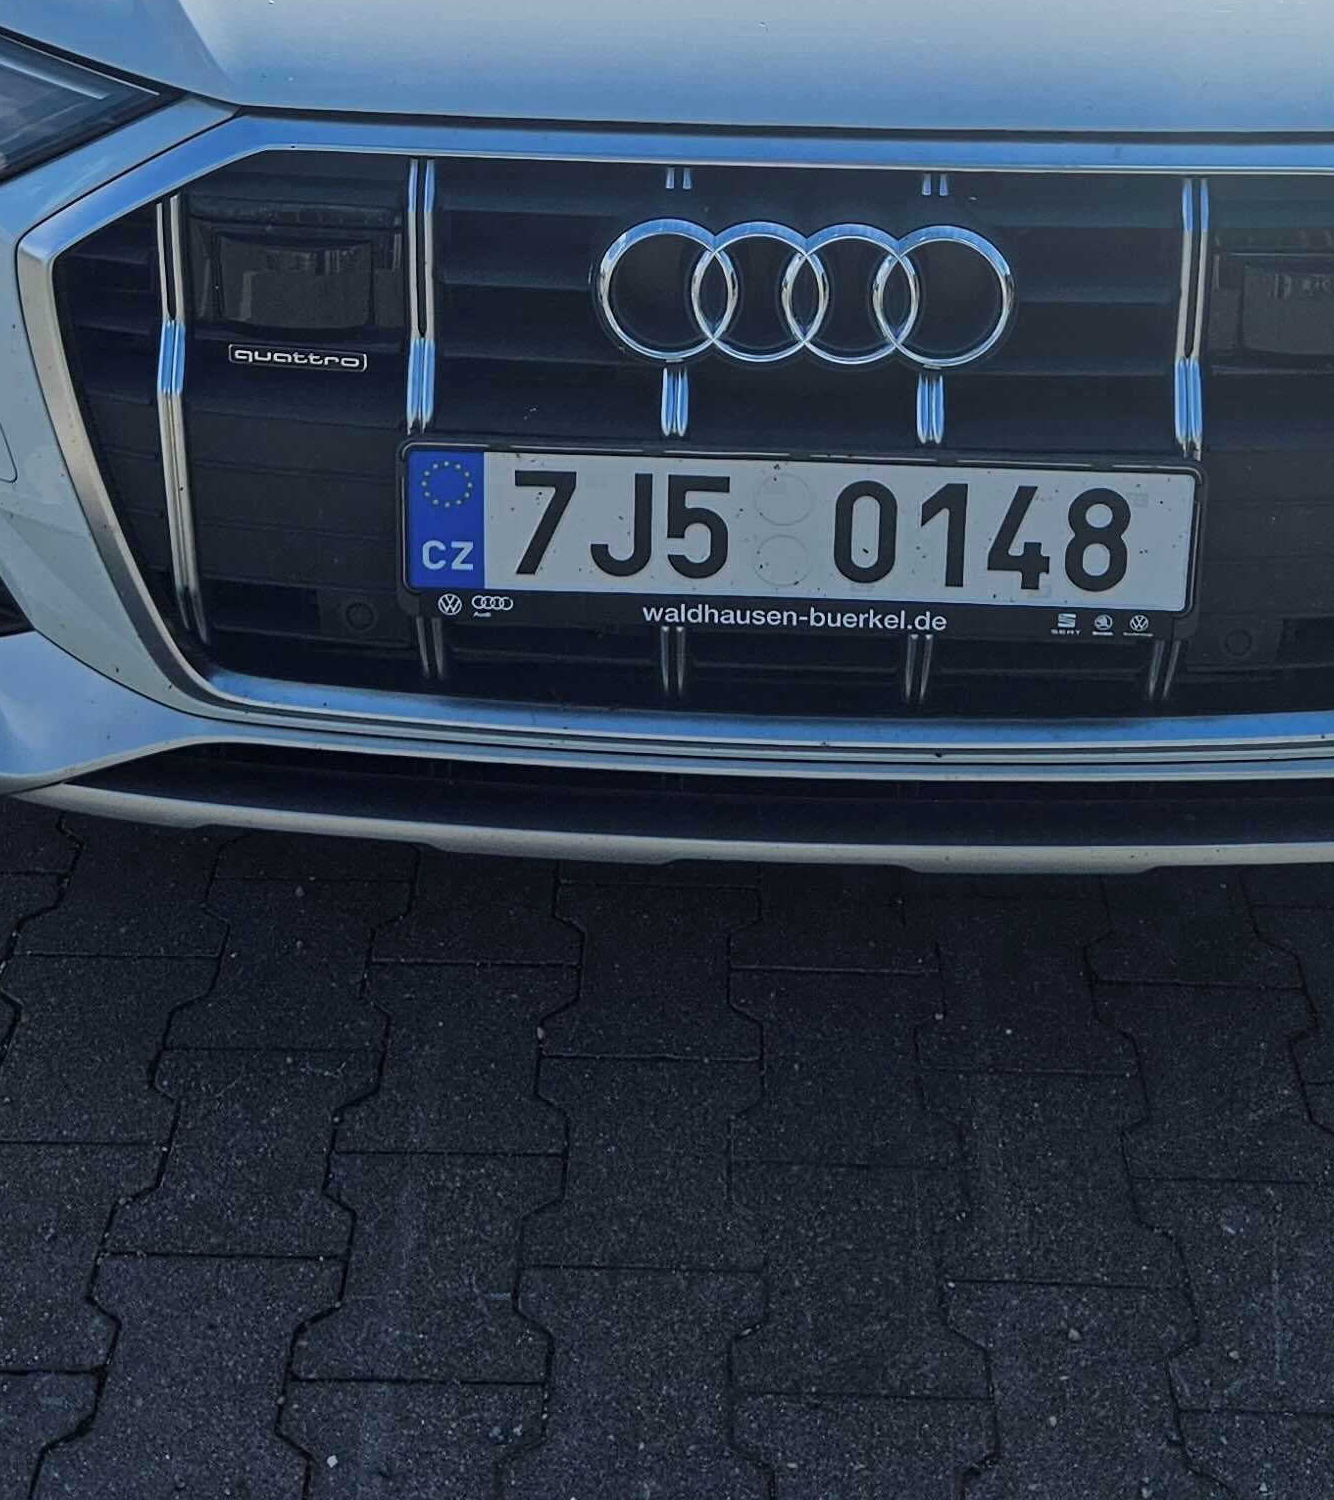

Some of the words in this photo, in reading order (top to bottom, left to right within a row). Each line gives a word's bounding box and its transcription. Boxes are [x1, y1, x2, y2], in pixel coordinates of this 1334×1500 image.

[234, 349, 360, 368] quattro
[514, 469, 732, 579] 7J5
[833, 479, 1133, 593] 0148
[421, 538, 475, 572] CZ
[642, 603, 948, 632] waldhausen-buerkel.de
